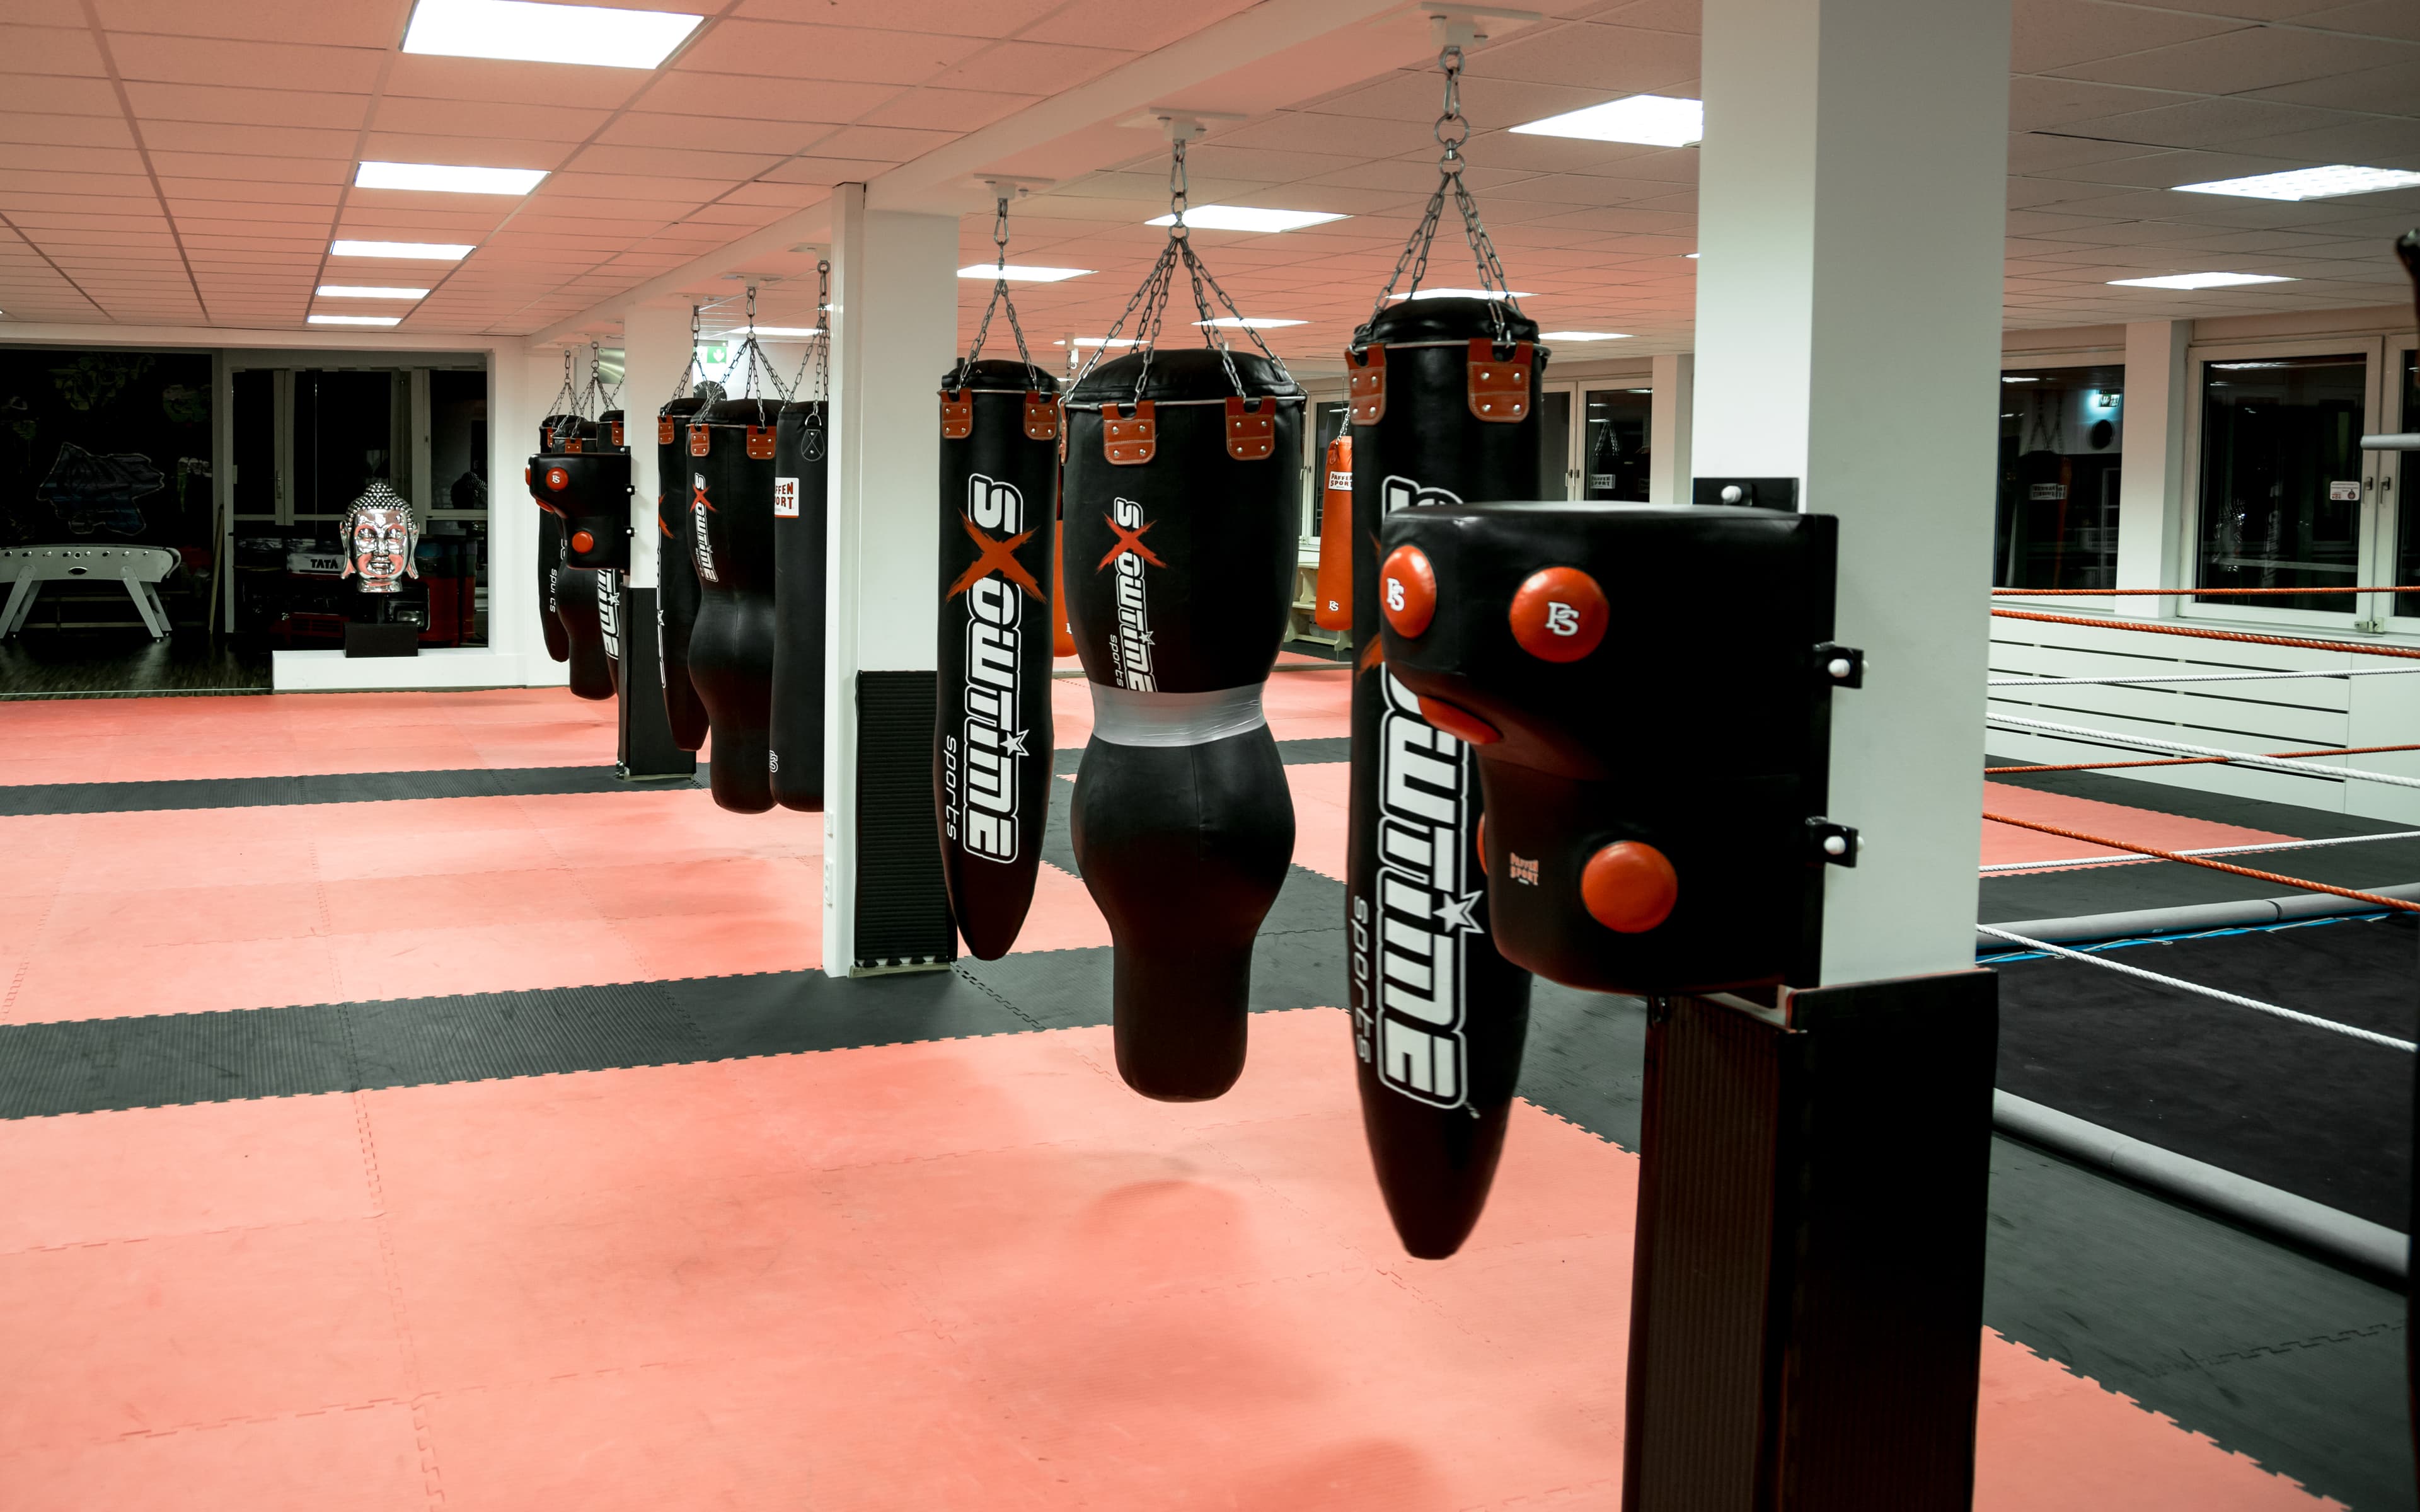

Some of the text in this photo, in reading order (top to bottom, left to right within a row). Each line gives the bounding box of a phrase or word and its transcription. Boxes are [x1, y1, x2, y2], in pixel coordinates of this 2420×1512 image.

[775, 496, 793, 509] ORT
[311, 559, 338, 570] TATA
[1545, 601, 1580, 636] PS
[1109, 634, 1124, 687] sports
[947, 735, 960, 841] sports
[1351, 895, 1374, 1063] sports
